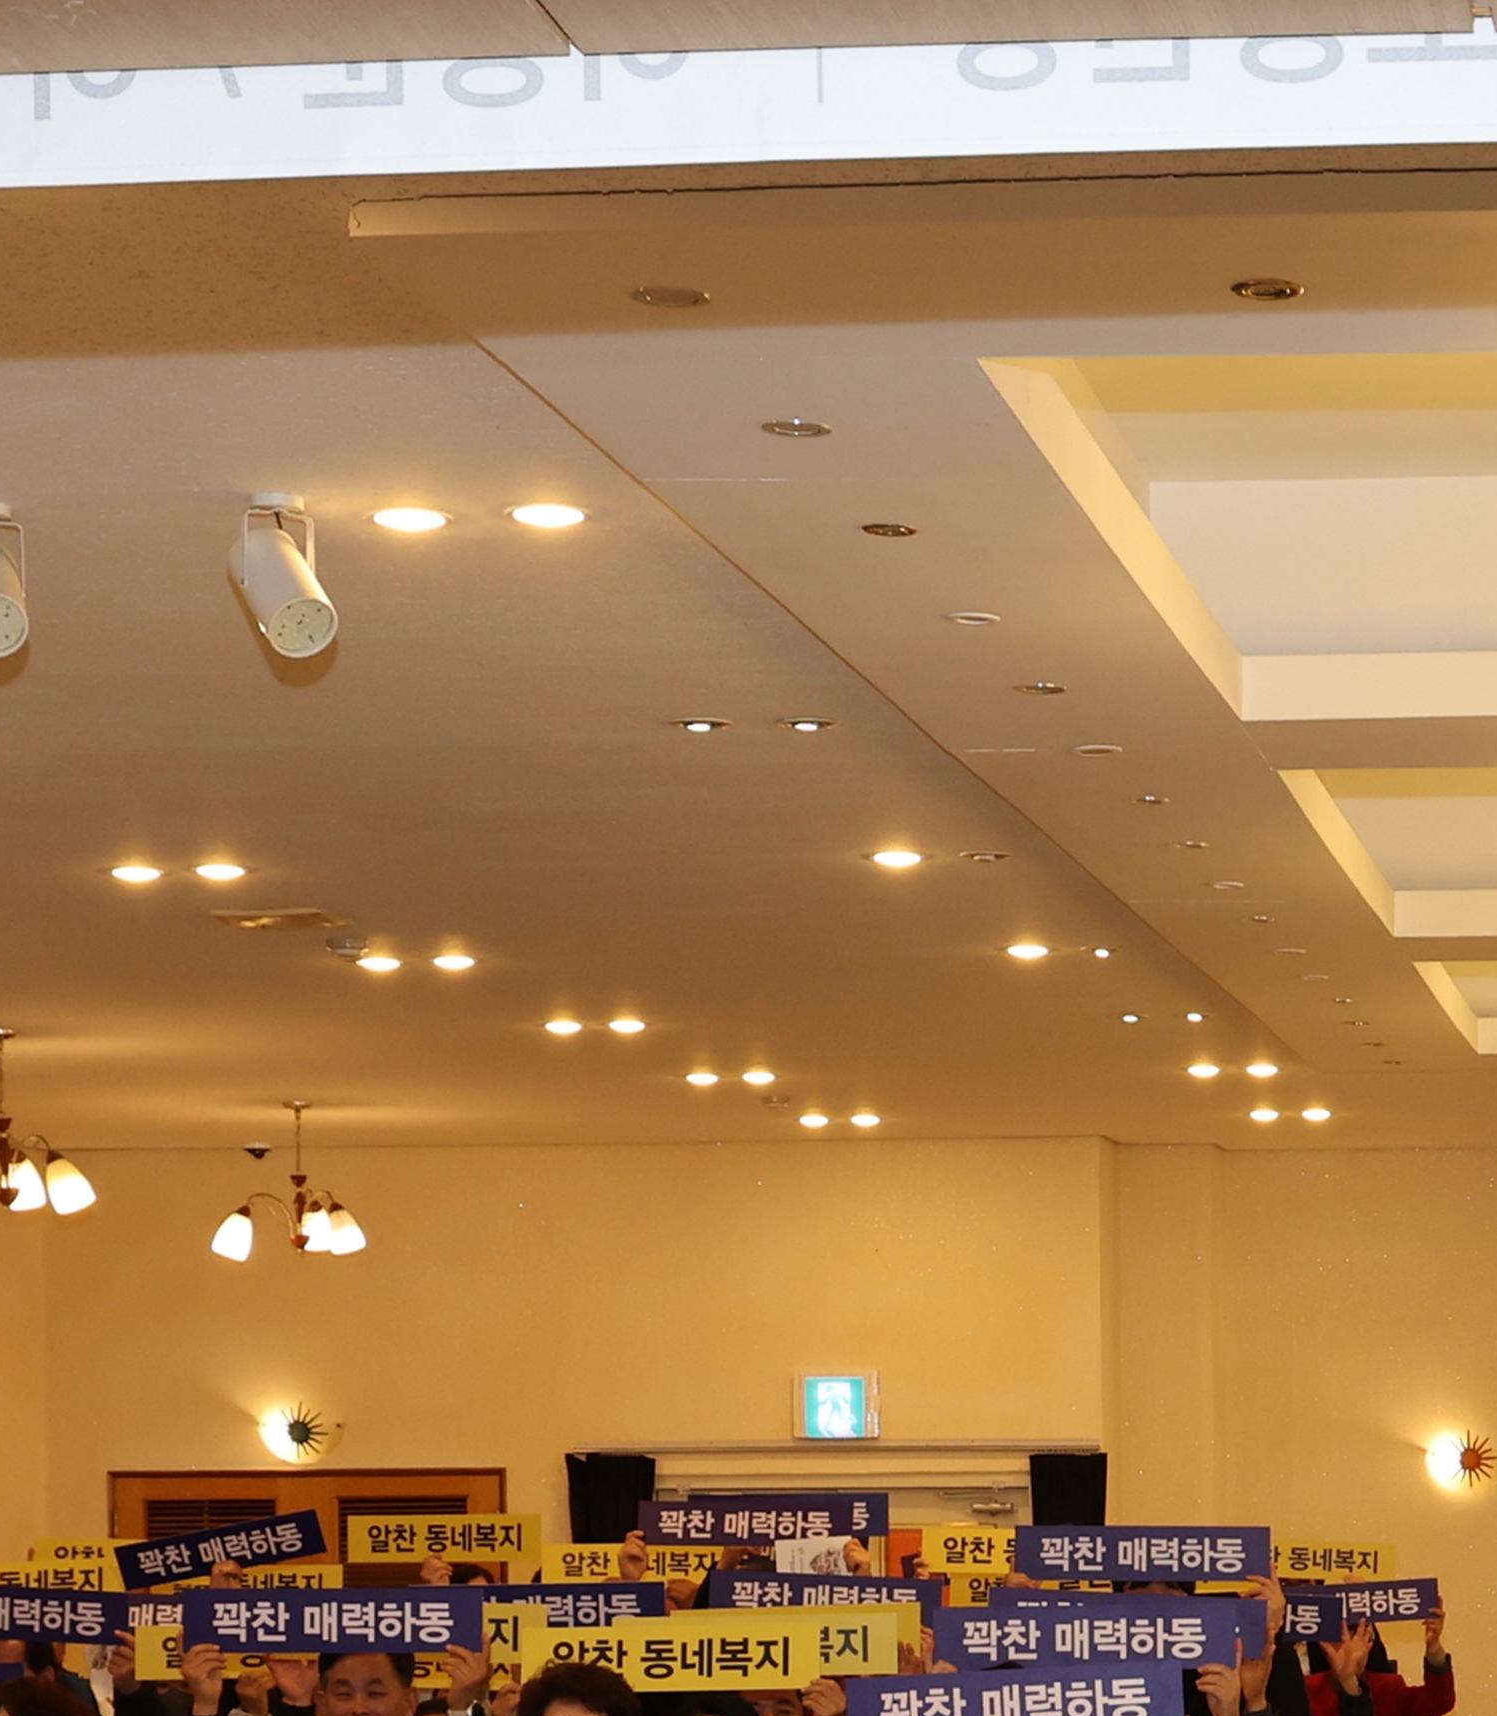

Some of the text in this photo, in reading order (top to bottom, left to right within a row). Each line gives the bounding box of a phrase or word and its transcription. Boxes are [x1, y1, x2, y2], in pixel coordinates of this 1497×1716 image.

[367, 1523, 523, 1553] 알찬 동네복지
[659, 1510, 715, 1539] 꽉찬
[724, 1510, 833, 1539] 매력하동
[136, 1521, 304, 1578] 꽉찬 매력하동
[561, 1551, 716, 1577] 알찬 네복지
[943, 1536, 996, 1566] 알찬
[1040, 1537, 1246, 1574] 꽉찬 매력하동
[1288, 1546, 1379, 1574] 동네복지
[211, 1601, 290, 1643] 꽉찬
[303, 1601, 454, 1643] 매력하동
[962, 1617, 1207, 1662] 꽉찬 매력하동
[640, 1636, 791, 1680] 동네복지
